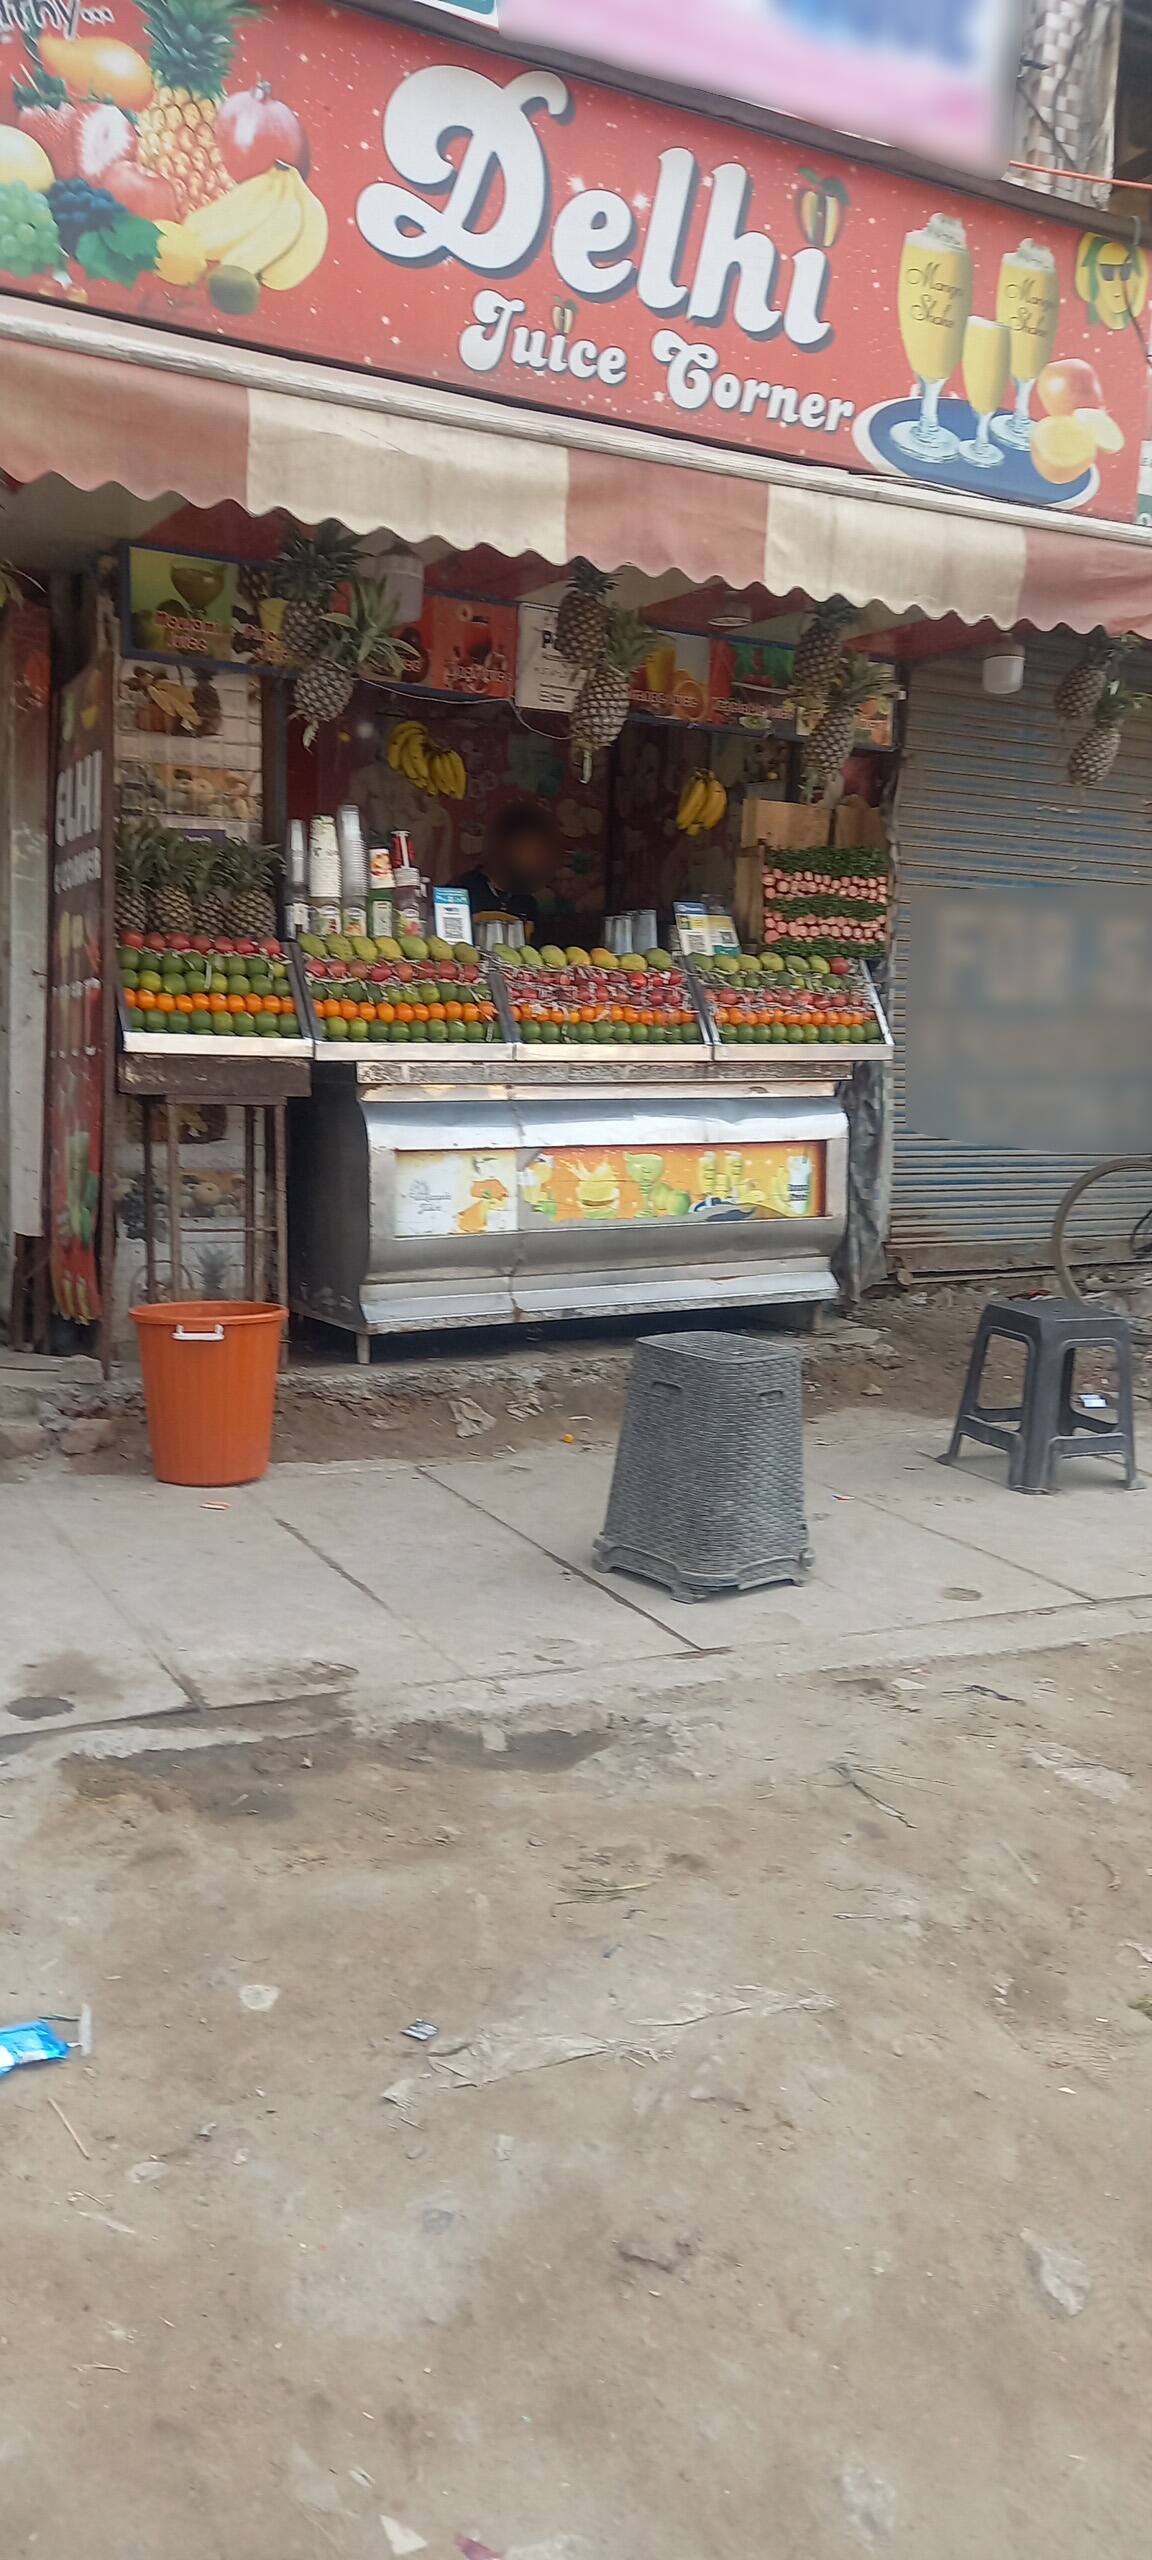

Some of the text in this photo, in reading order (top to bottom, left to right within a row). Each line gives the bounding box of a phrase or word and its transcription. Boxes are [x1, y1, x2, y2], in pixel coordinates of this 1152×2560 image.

[355, 65, 833, 350] Delhi
[459, 288, 856, 432] Juice Corner
